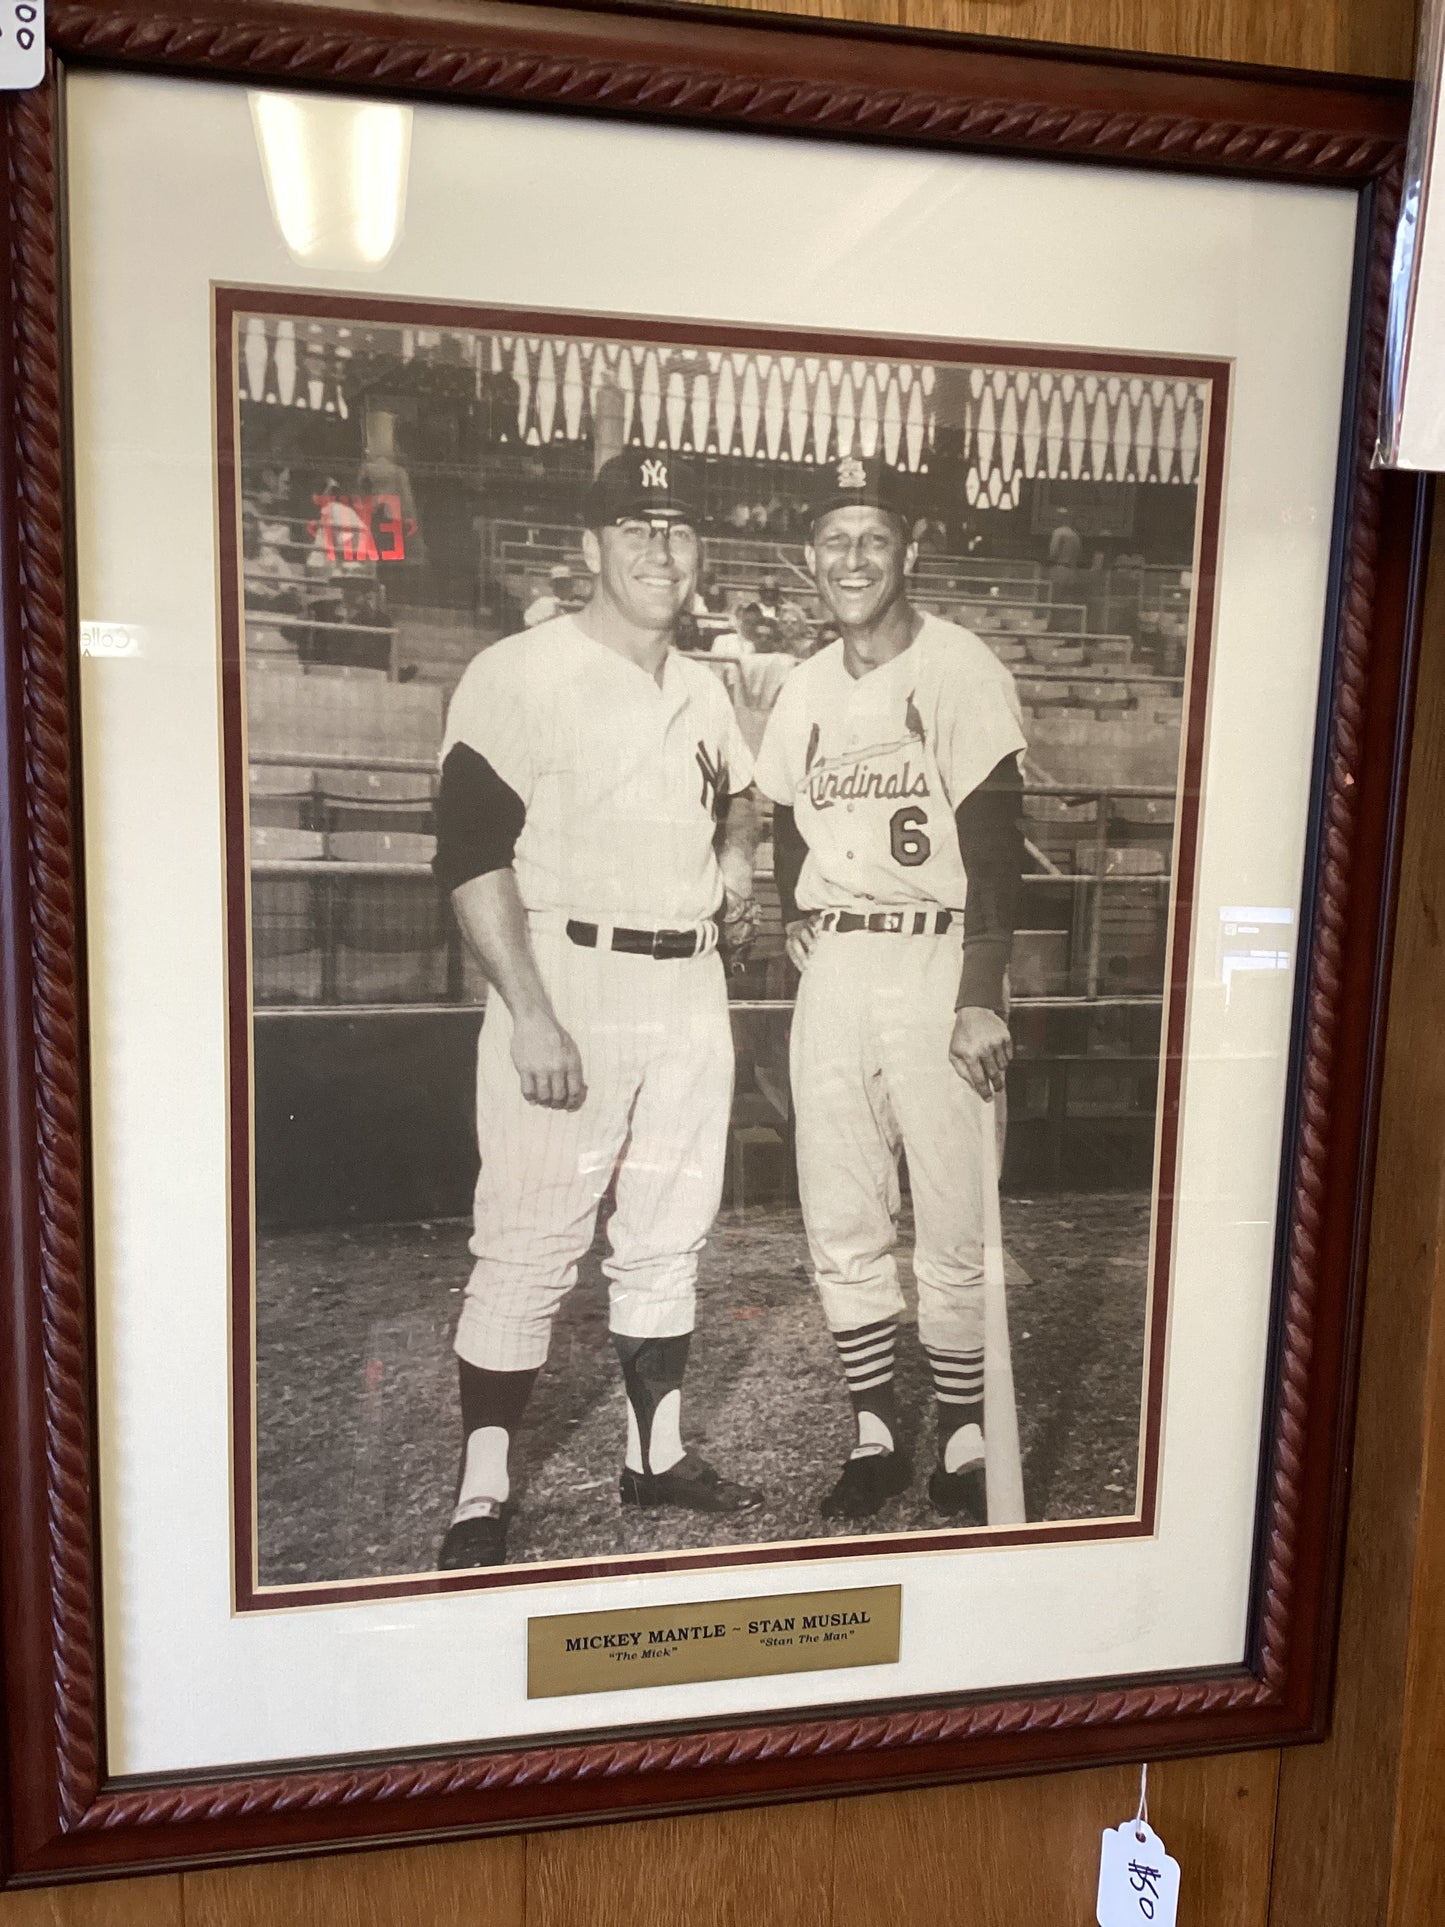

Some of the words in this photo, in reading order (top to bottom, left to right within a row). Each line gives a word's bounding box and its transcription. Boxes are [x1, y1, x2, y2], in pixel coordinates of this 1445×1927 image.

[15, 0, 37, 50] 00
[640, 459, 668, 488] NY
[889, 805, 931, 867] 6
[565, 1632, 642, 1652] MICKEY
[648, 1624, 726, 1644] MANTLE
[748, 1618, 795, 1634] STAN
[802, 1611, 871, 1629] MUSIAL
[799, 1634, 819, 1644] The
[1128, 1859, 1162, 1920] $50
